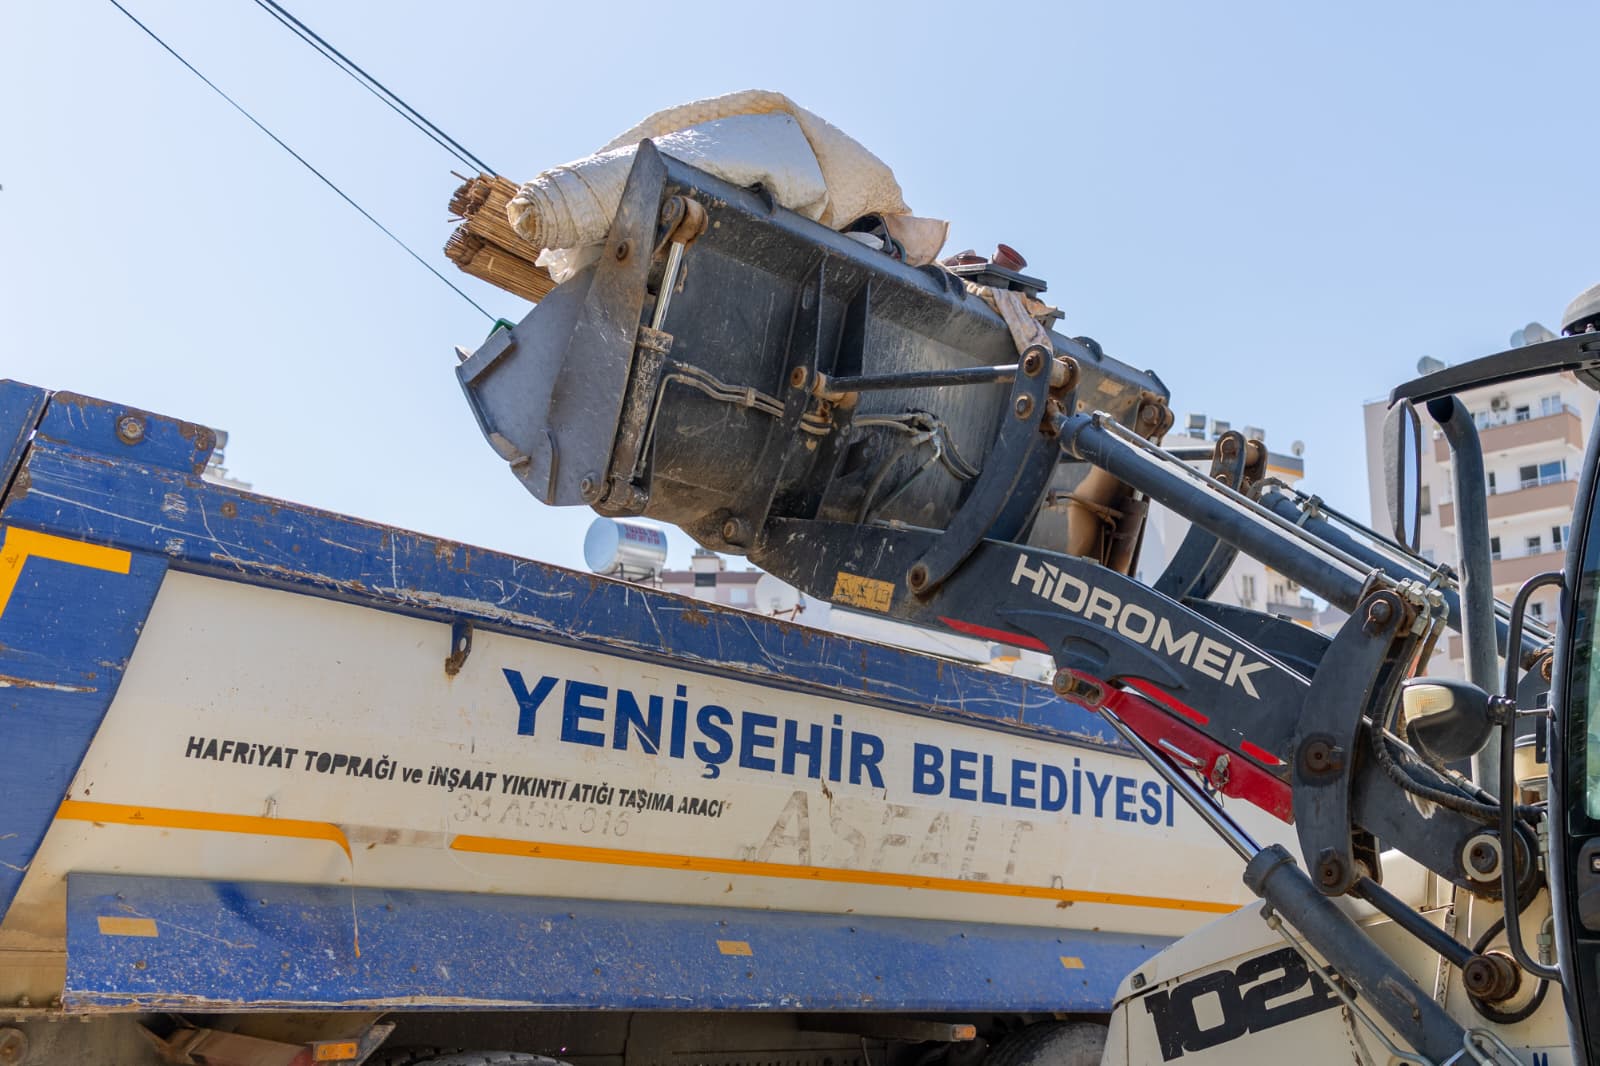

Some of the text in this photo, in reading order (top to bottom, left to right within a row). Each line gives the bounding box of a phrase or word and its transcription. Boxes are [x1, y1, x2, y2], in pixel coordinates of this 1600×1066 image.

[502, 668, 886, 789] YENİŞEHİR
[305, 750, 397, 780] TOPRAĞI
[402, 767, 423, 784] ve
[501, 773, 567, 800] YIKINTI
[568, 781, 614, 806] ATIĞI
[618, 788, 674, 814] TAŞIMA
[677, 796, 724, 818] ARACI
